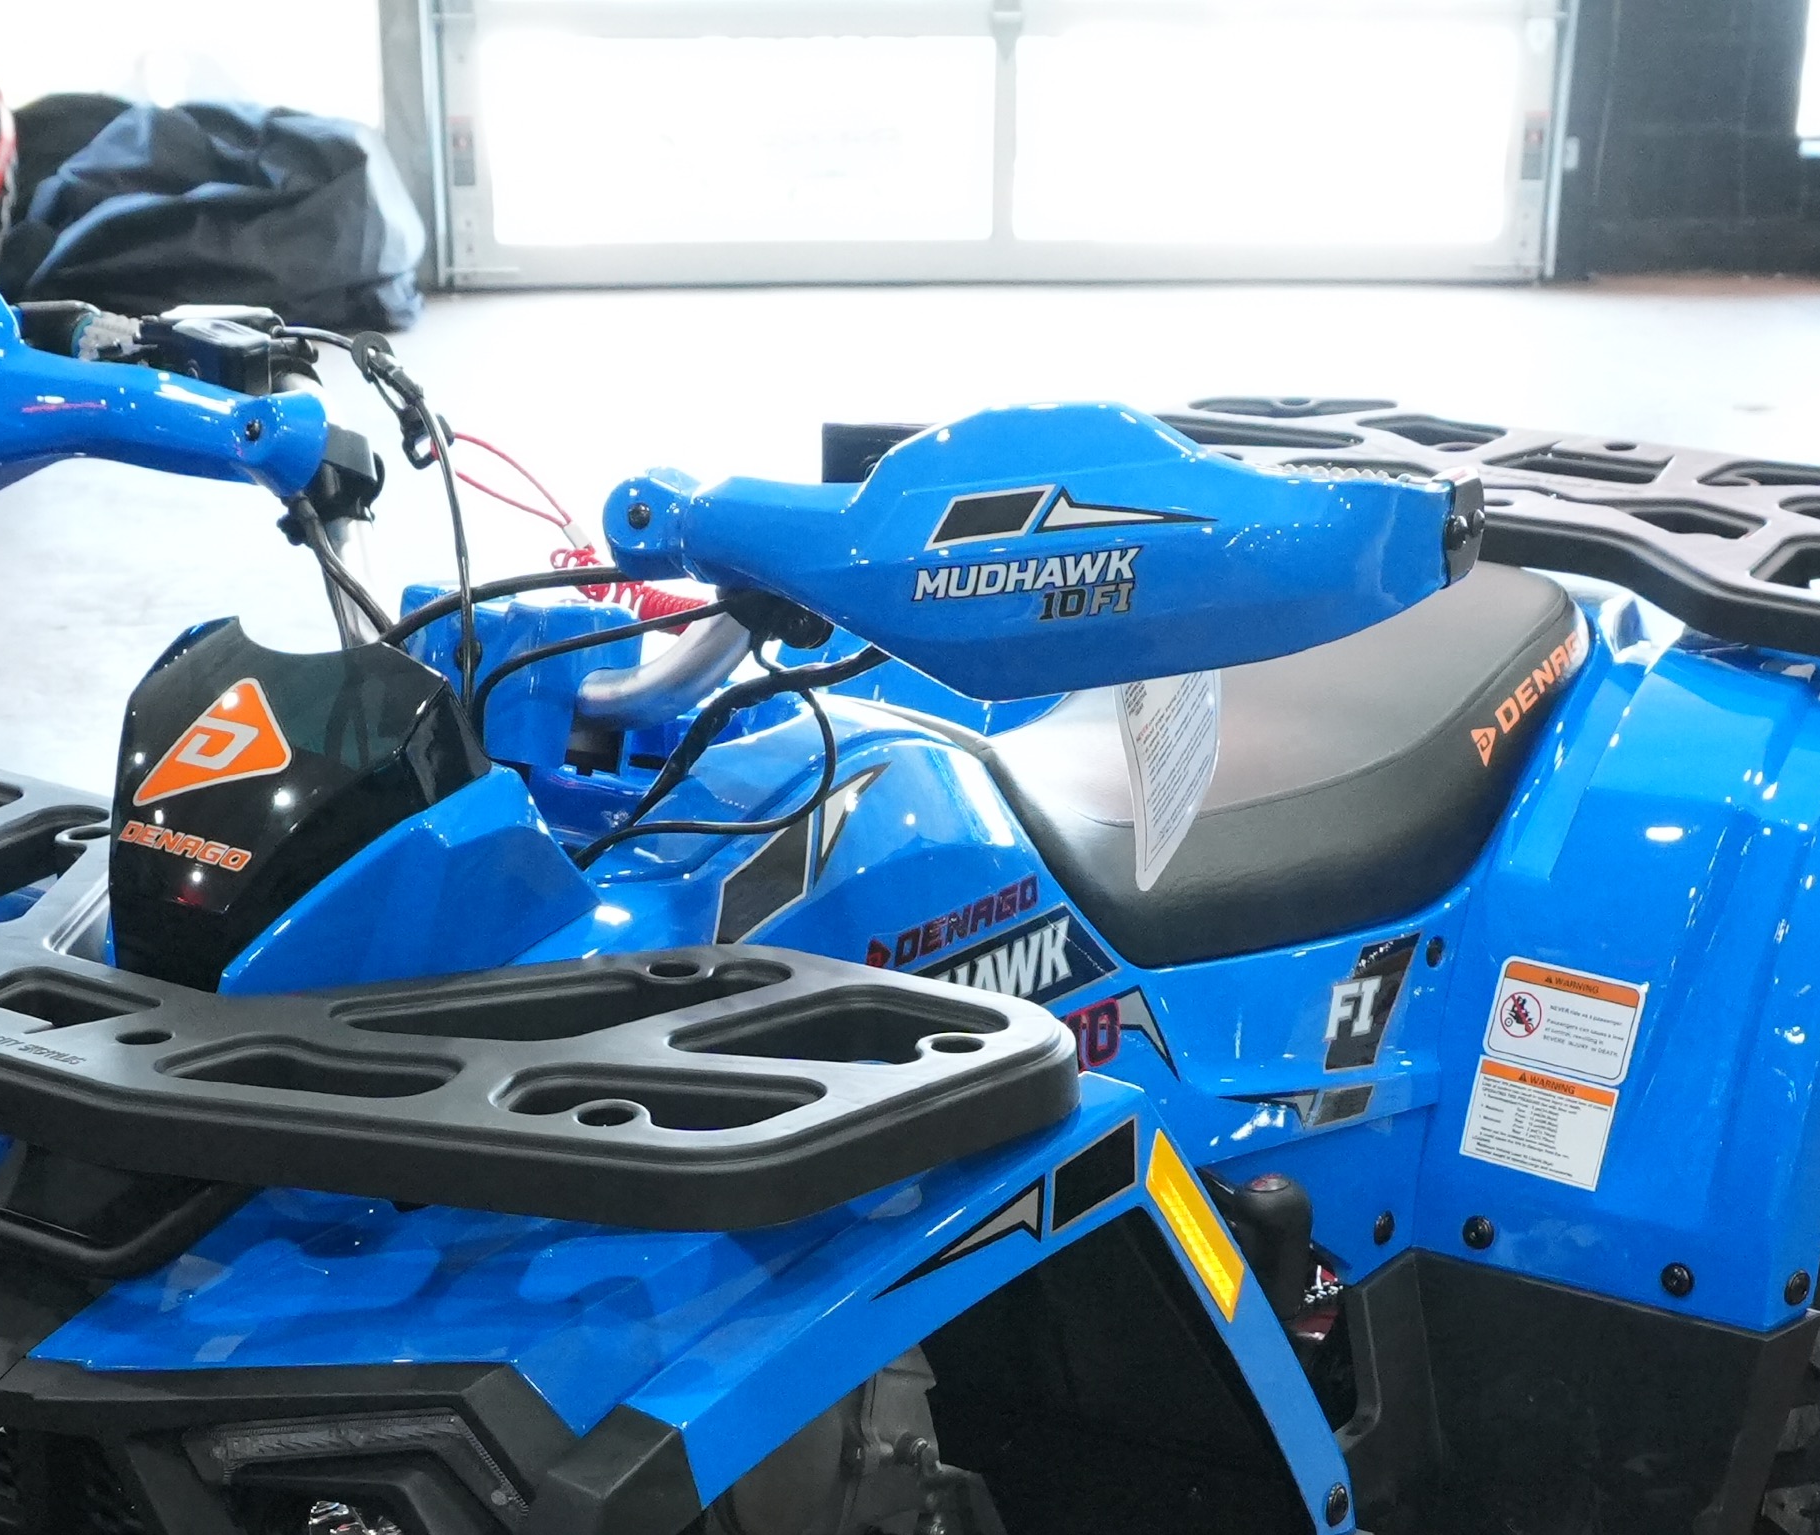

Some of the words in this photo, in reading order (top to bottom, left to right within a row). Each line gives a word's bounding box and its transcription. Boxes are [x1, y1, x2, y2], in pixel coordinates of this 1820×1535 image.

[911, 545, 1144, 601] MUDHAWK
[119, 819, 253, 872] DENAGO
[894, 873, 1040, 968] DENAGO
[1323, 975, 1383, 1043] FI
[1554, 976, 1601, 995] WARNING
[1529, 1074, 1576, 1096] WARNING
